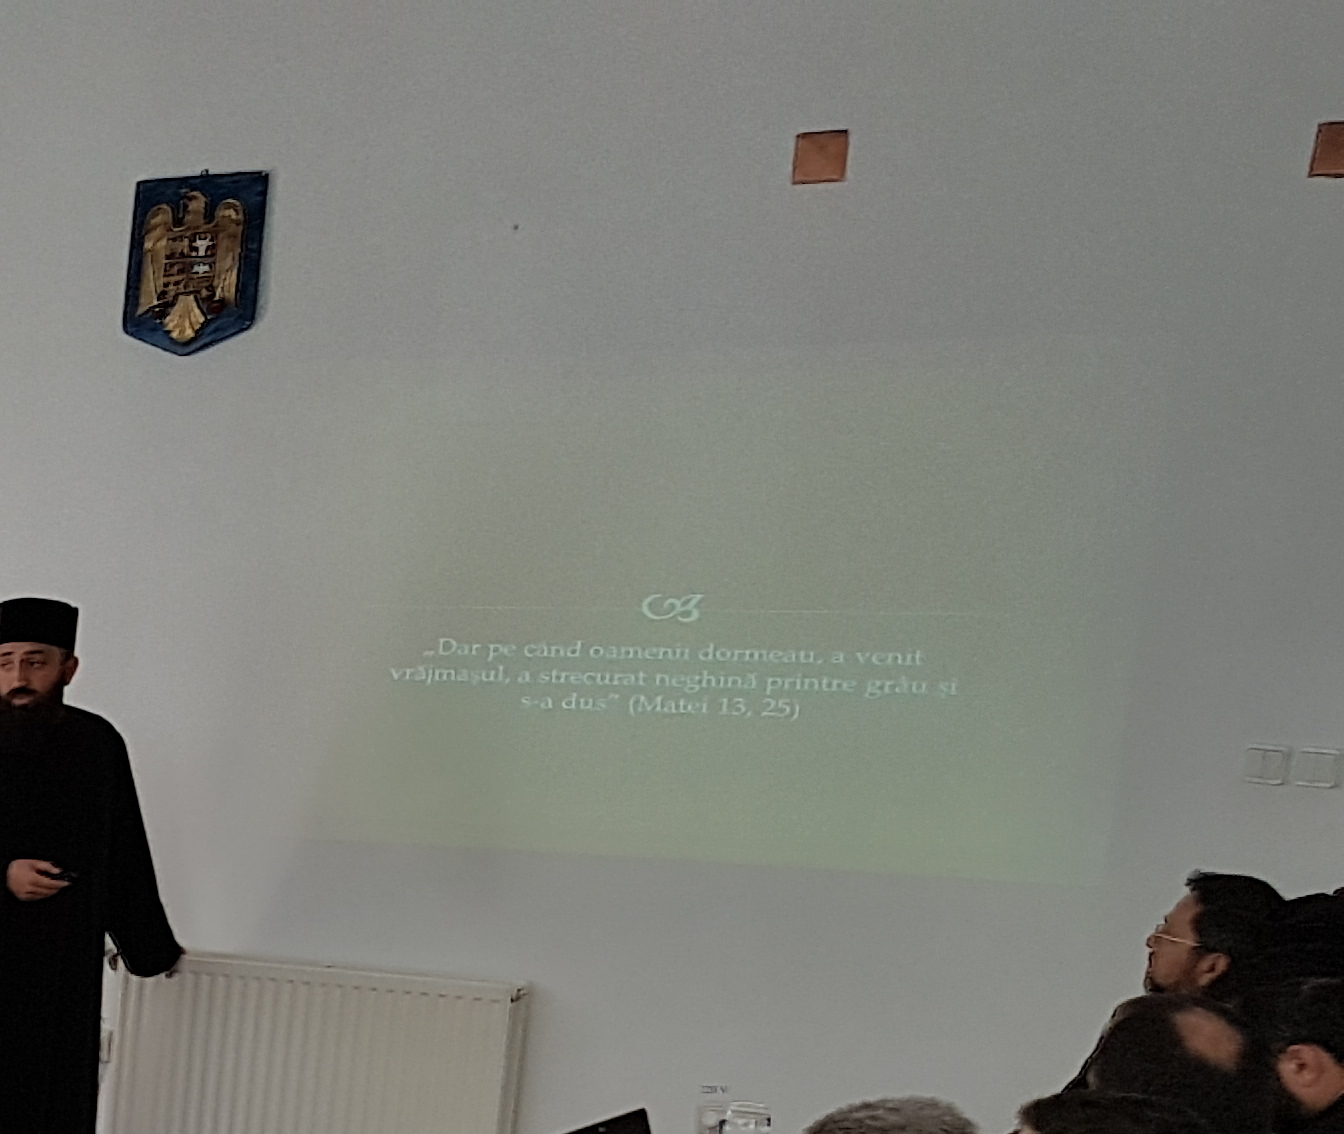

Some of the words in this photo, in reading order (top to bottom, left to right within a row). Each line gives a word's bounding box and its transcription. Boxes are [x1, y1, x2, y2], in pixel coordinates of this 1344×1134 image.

[486, 643, 517, 662] pe
[523, 640, 583, 659] când
[588, 642, 691, 661] oamenii
[697, 643, 823, 664] dormeau,
[830, 650, 846, 664] a
[855, 649, 924, 666] venit
[516, 669, 531, 683] a
[537, 669, 648, 686] strecurat
[654, 669, 758, 693] neghină
[765, 672, 857, 695] printre
[519, 694, 554, 710] s-a
[627, 694, 709, 717] (Matei
[718, 697, 752, 717] 13,
[759, 697, 801, 721] 25)
